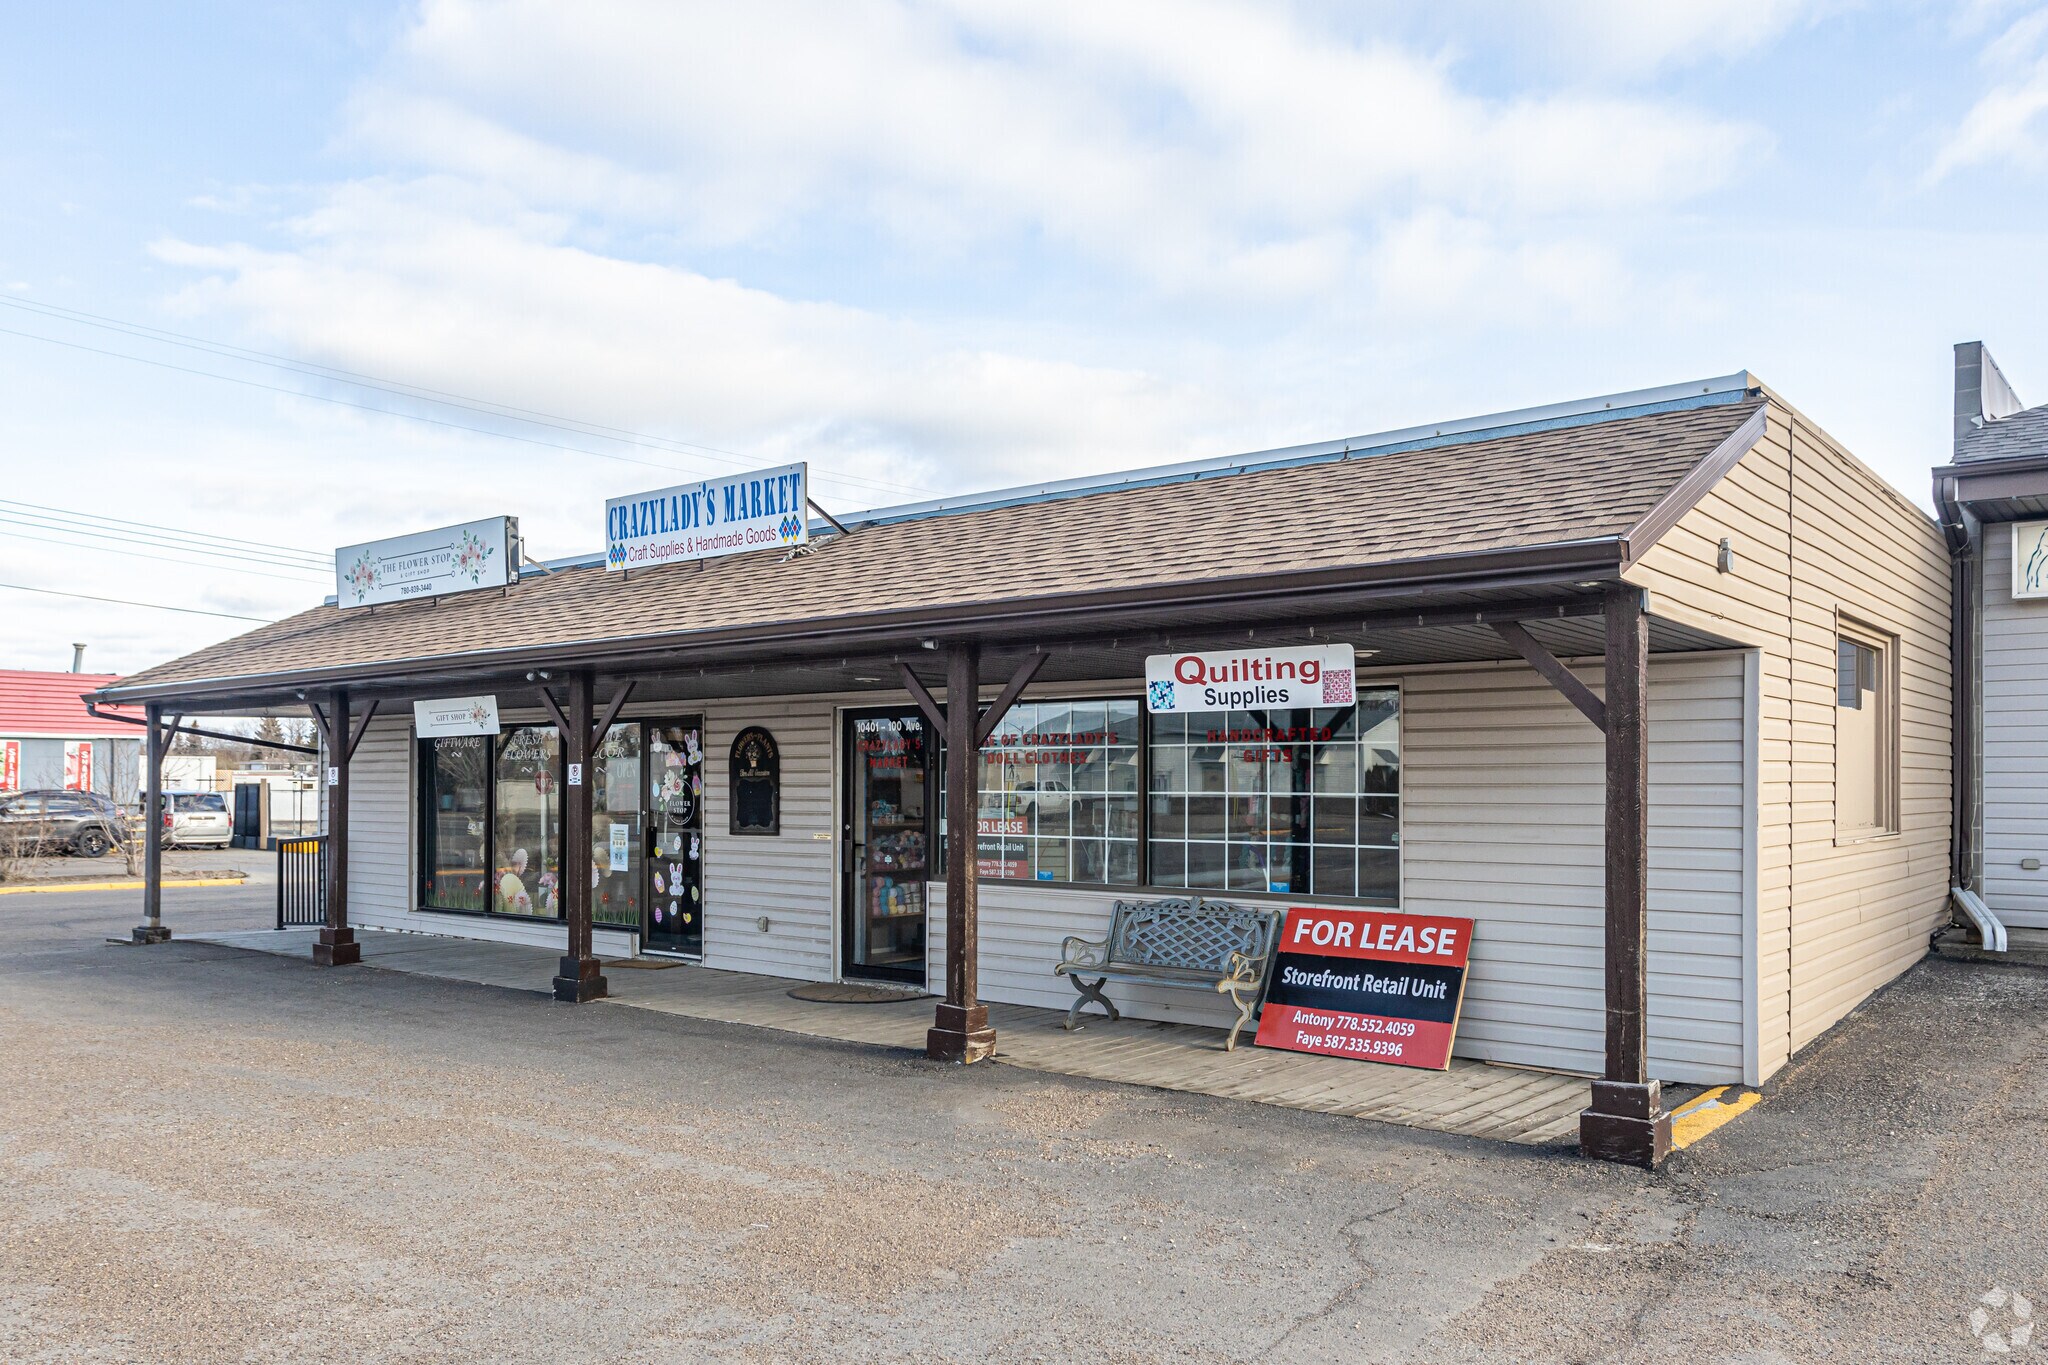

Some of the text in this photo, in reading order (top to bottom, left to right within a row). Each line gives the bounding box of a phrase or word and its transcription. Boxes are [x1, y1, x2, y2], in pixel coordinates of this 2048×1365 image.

[608, 472, 800, 542] CRAZYLADY'S MARKET
[628, 525, 777, 562] Craft Supplies & Handmade Goods
[382, 552, 451, 573] THE FLOWER STOP
[1174, 655, 1320, 686] Quilting
[1204, 685, 1290, 709] Supplies
[450, 713, 466, 721] SHOP
[857, 721, 879, 733] 10401
[888, 720, 902, 732] 100
[906, 720, 923, 731] Ave.
[1001, 734, 1018, 746] OF
[1022, 731, 1119, 746] CRAZYLADY'S
[1207, 727, 1333, 743] HANDCRAFTED
[434, 736, 481, 752] GIFTWARE
[857, 738, 920, 751] CRAZYLADY'S
[503, 749, 552, 761] FLOWERS
[869, 755, 908, 769] MARKET
[987, 751, 1088, 765] DOLL CLOTHES
[1243, 749, 1293, 763] GIFTS
[977, 821, 1023, 833] OR LEASE
[977, 842, 996, 851] refront
[1012, 844, 1024, 852] Unit
[1293, 918, 1457, 956] FOR LEASE
[1281, 966, 1448, 1000] Storefront Retail Unit
[1292, 1010, 1416, 1037] Antony 778.552.4059
[1296, 1030, 1402, 1056] Faye 587.335.9396
